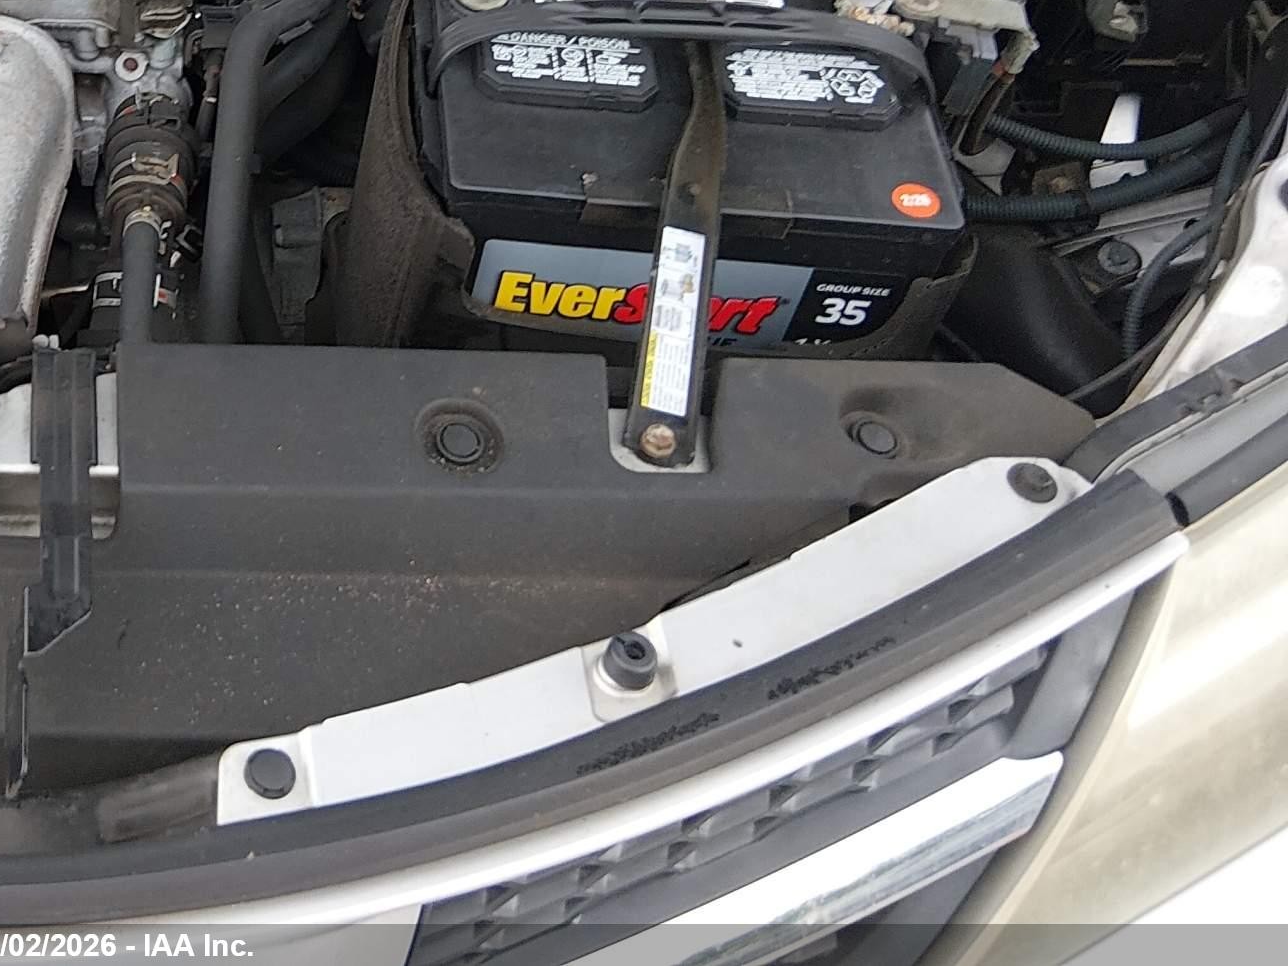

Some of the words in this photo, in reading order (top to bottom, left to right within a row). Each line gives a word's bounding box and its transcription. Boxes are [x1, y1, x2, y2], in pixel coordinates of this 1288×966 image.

[816, 283, 863, 295] GROUP
[862, 286, 891, 297] SIZE
[815, 297, 872, 326] 35
